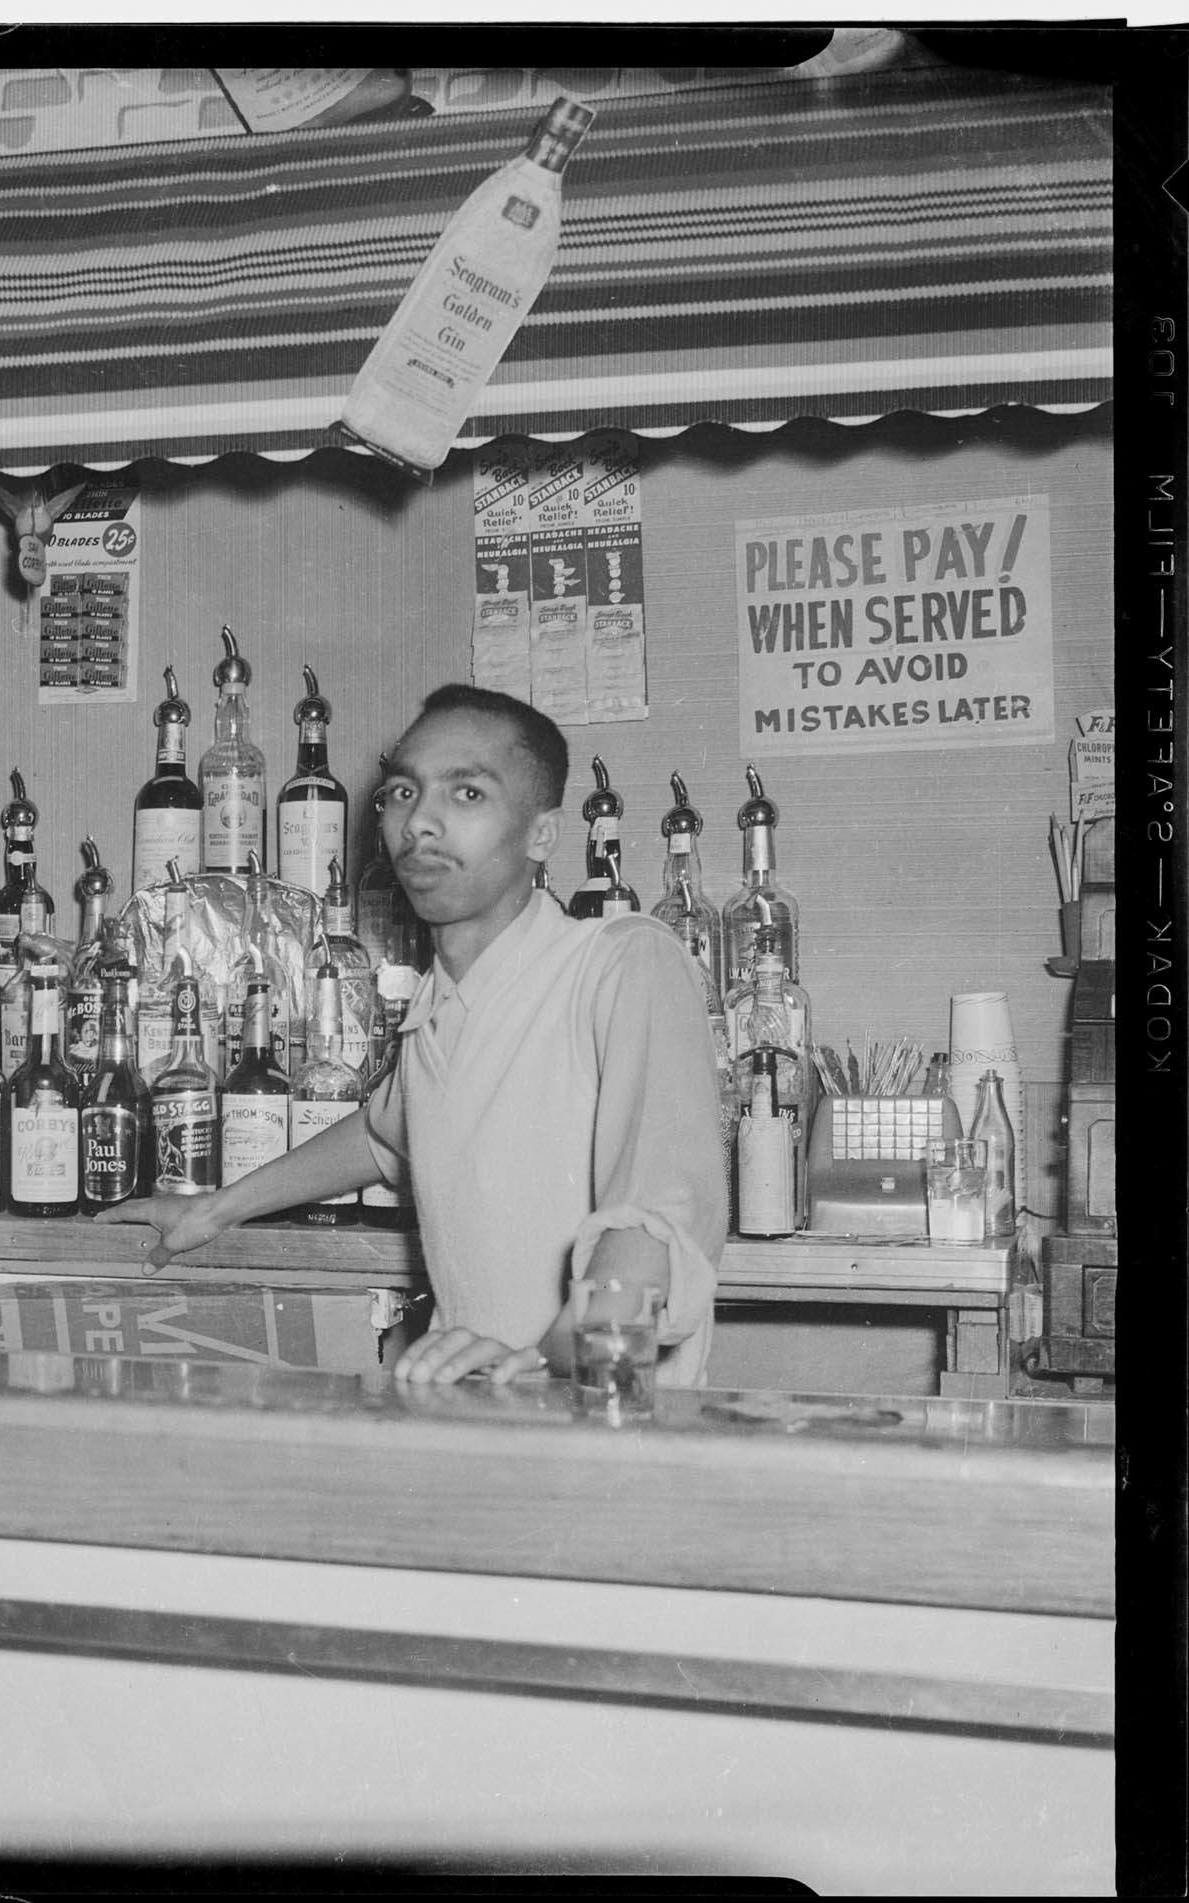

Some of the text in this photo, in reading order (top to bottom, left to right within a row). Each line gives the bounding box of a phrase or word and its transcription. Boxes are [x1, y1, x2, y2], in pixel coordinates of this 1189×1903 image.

[446, 256, 522, 309] Seagram's
[442, 294, 493, 332] Golden
[438, 326, 466, 352] Gin
[474, 473, 527, 512] STANBACK
[529, 465, 582, 507] STANBACK
[623, 482, 635, 496] 10
[512, 493, 524, 506] 10
[568, 488, 579, 501] 10
[542, 502, 572, 513] Quick
[597, 497, 628, 508] Quick
[74, 511, 110, 520] BLADES
[486, 508, 517, 518] Quick
[532, 529, 583, 540] HEADACHE
[587, 524, 639, 535] HEADACHE
[57, 536, 100, 547] BLADES
[105, 529, 135, 551] 25¢
[587, 537, 639, 549] NEURALGIA
[476, 548, 528, 559] NEURALGIA
[532, 542, 583, 553] NEURALGIA
[745, 513, 1027, 593] PLEASE PAY!
[747, 585, 1027, 654] WHEN SERVED
[792, 652, 968, 689] TO AVOID
[755, 694, 1031, 733] MISTAKES LATER
[1084, 755, 1112, 764] MINTS
[87, 1138, 122, 1157] Paul
[84, 1156, 127, 1173] Jones
